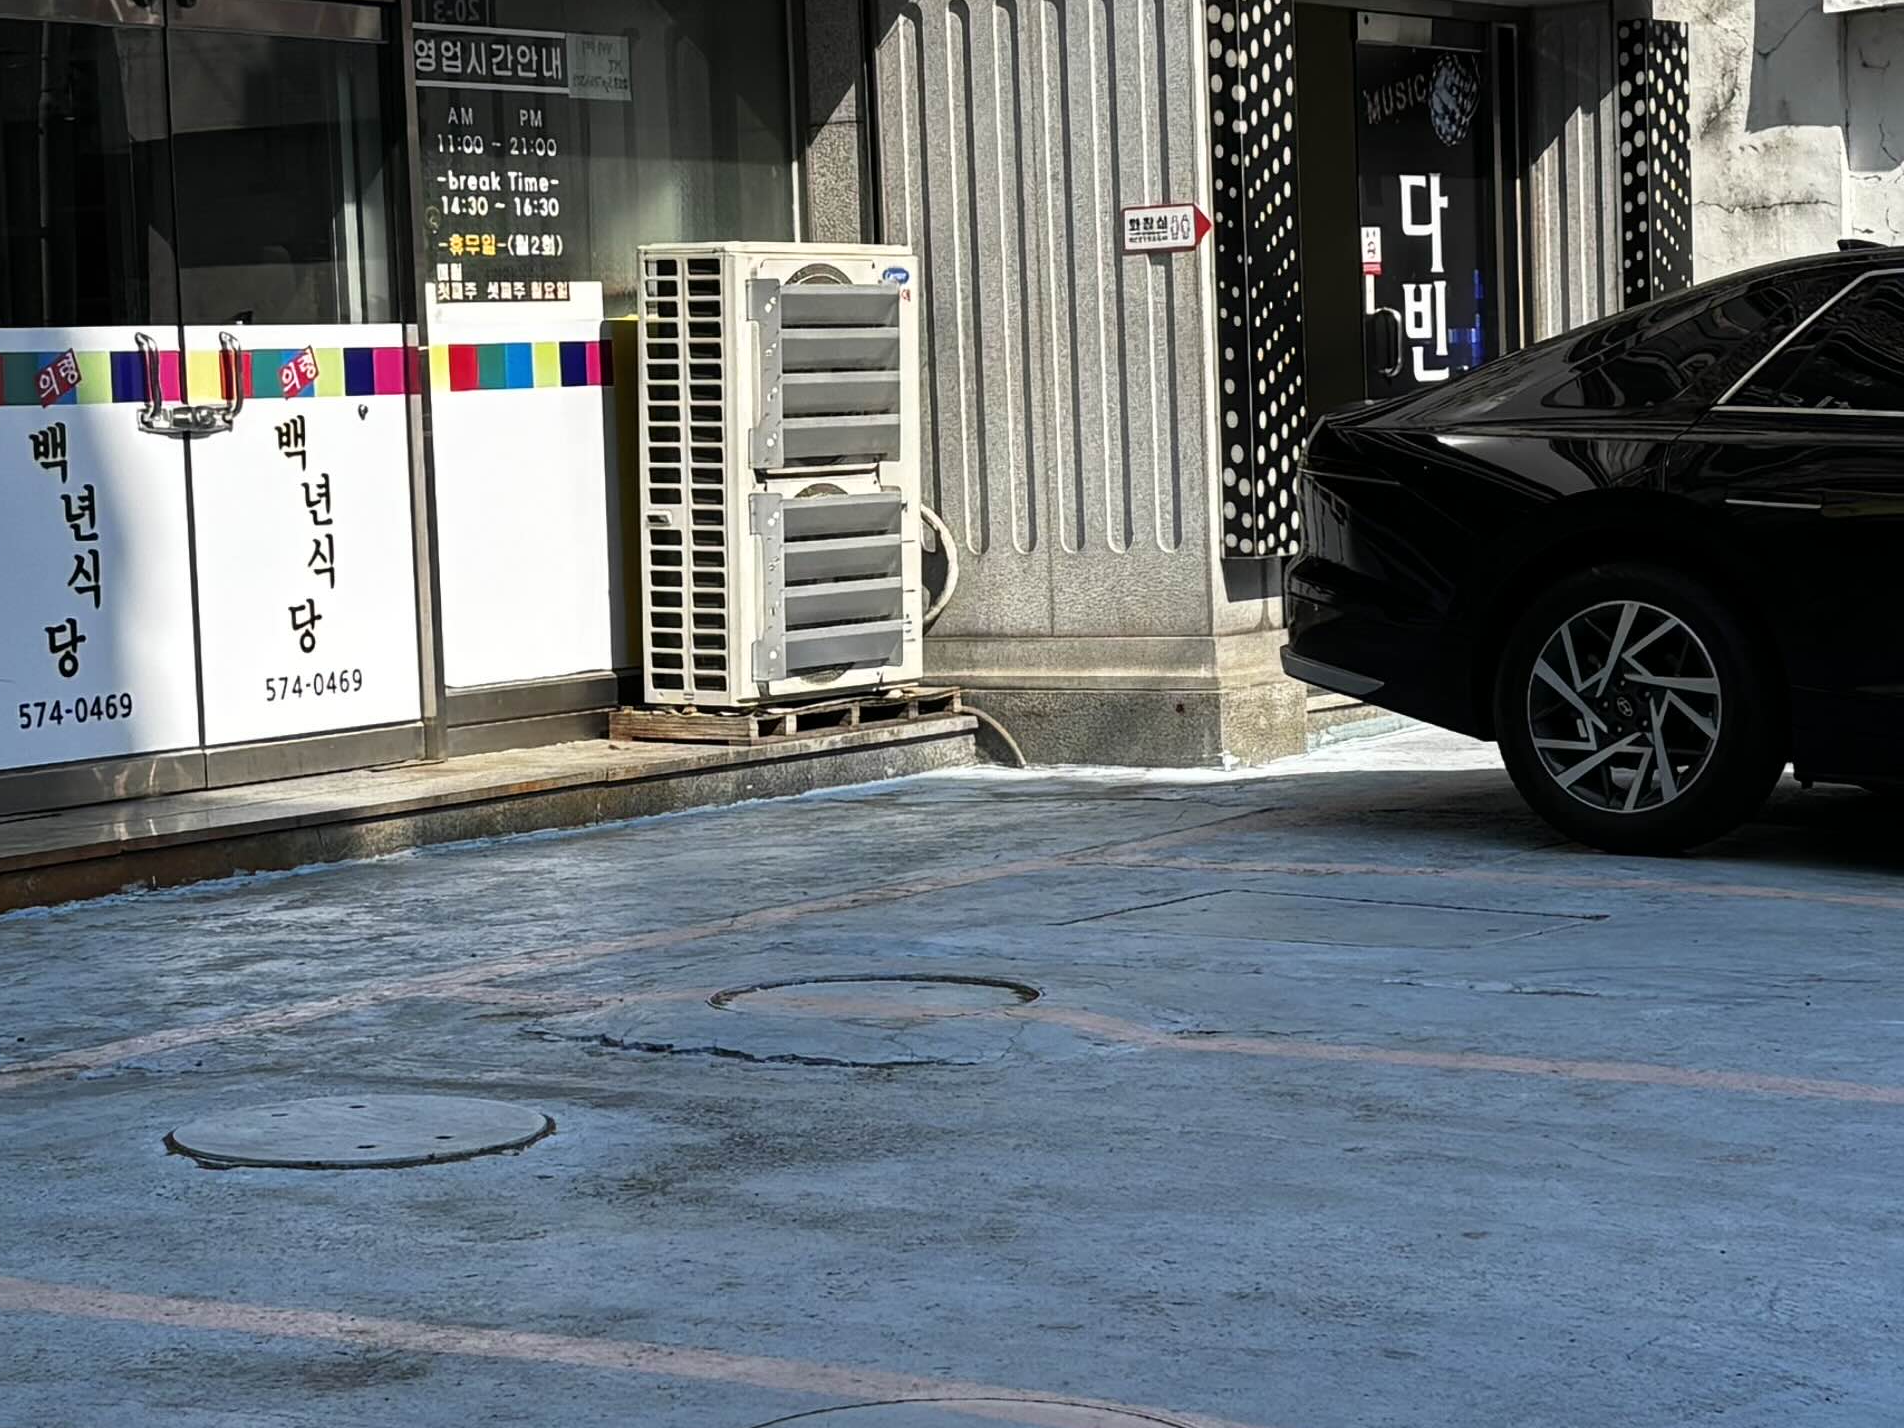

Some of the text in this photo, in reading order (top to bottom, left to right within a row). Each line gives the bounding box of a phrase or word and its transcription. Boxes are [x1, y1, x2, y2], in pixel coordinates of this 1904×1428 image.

[414, 38, 563, 80] 영업시간안내
[447, 107, 543, 127] AM PM
[1362, 73, 1427, 124] MUSIC
[437, 134, 484, 155] 11:00
[509, 136, 557, 157] 21:00
[441, 195, 488, 216] 14:30
[514, 197, 560, 217] 16:30
[39, 351, 78, 397] 의령
[281, 350, 319, 394] 의령
[29, 422, 101, 677] 백년식당
[274, 414, 335, 653] 백년식당
[265, 668, 363, 702] 574-0469
[19, 692, 134, 730] 574-0469
